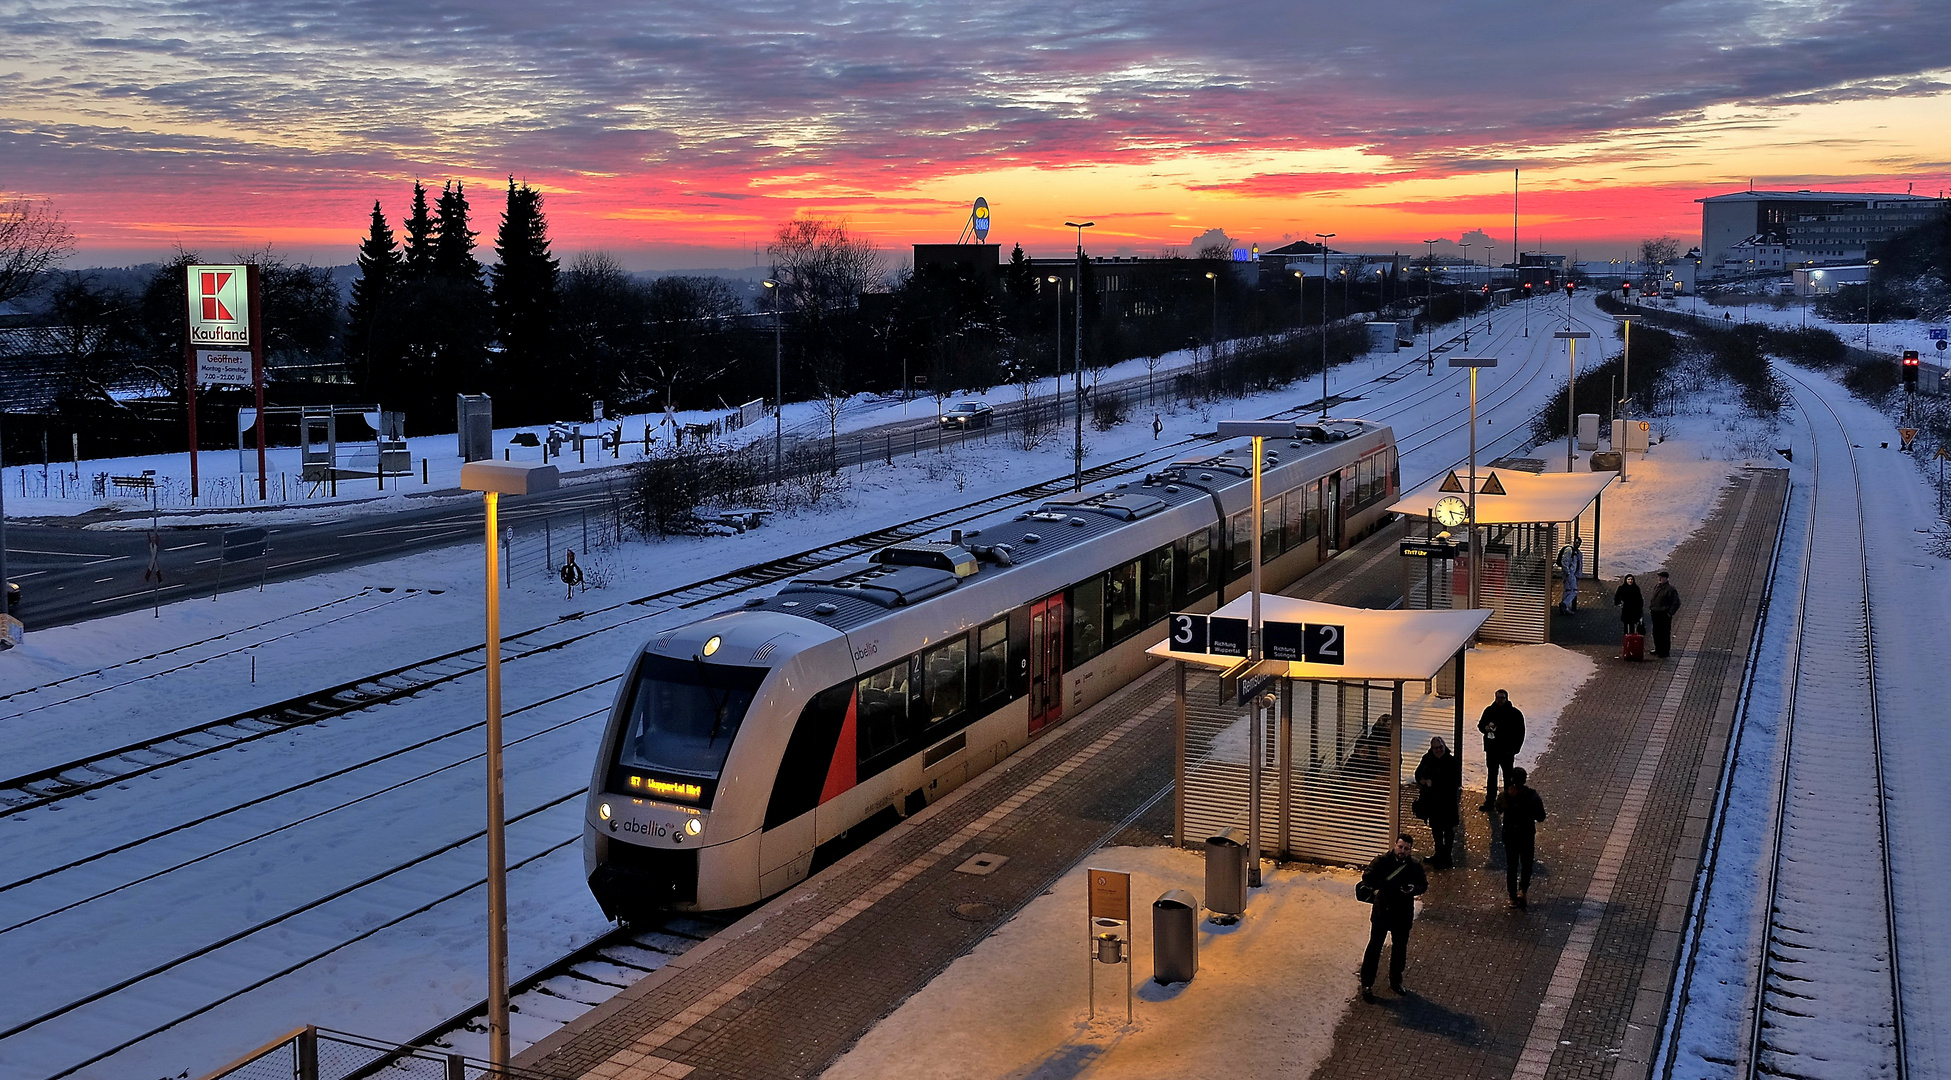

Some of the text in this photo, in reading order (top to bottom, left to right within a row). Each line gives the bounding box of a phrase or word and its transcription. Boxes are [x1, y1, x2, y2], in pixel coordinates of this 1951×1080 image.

[191, 326, 248, 341] Kaufland
[207, 354, 243, 364] Geöffnet:
[201, 364, 221, 373] Montag
[1906, 431, 1910, 440] 5
[1174, 615, 1193, 644] 3
[1214, 640, 1237, 649] Richtung
[1319, 625, 1338, 656] 2
[1273, 645, 1296, 654] Richtung
[914, 654, 920, 673] 2
[623, 818, 667, 837] abellio
